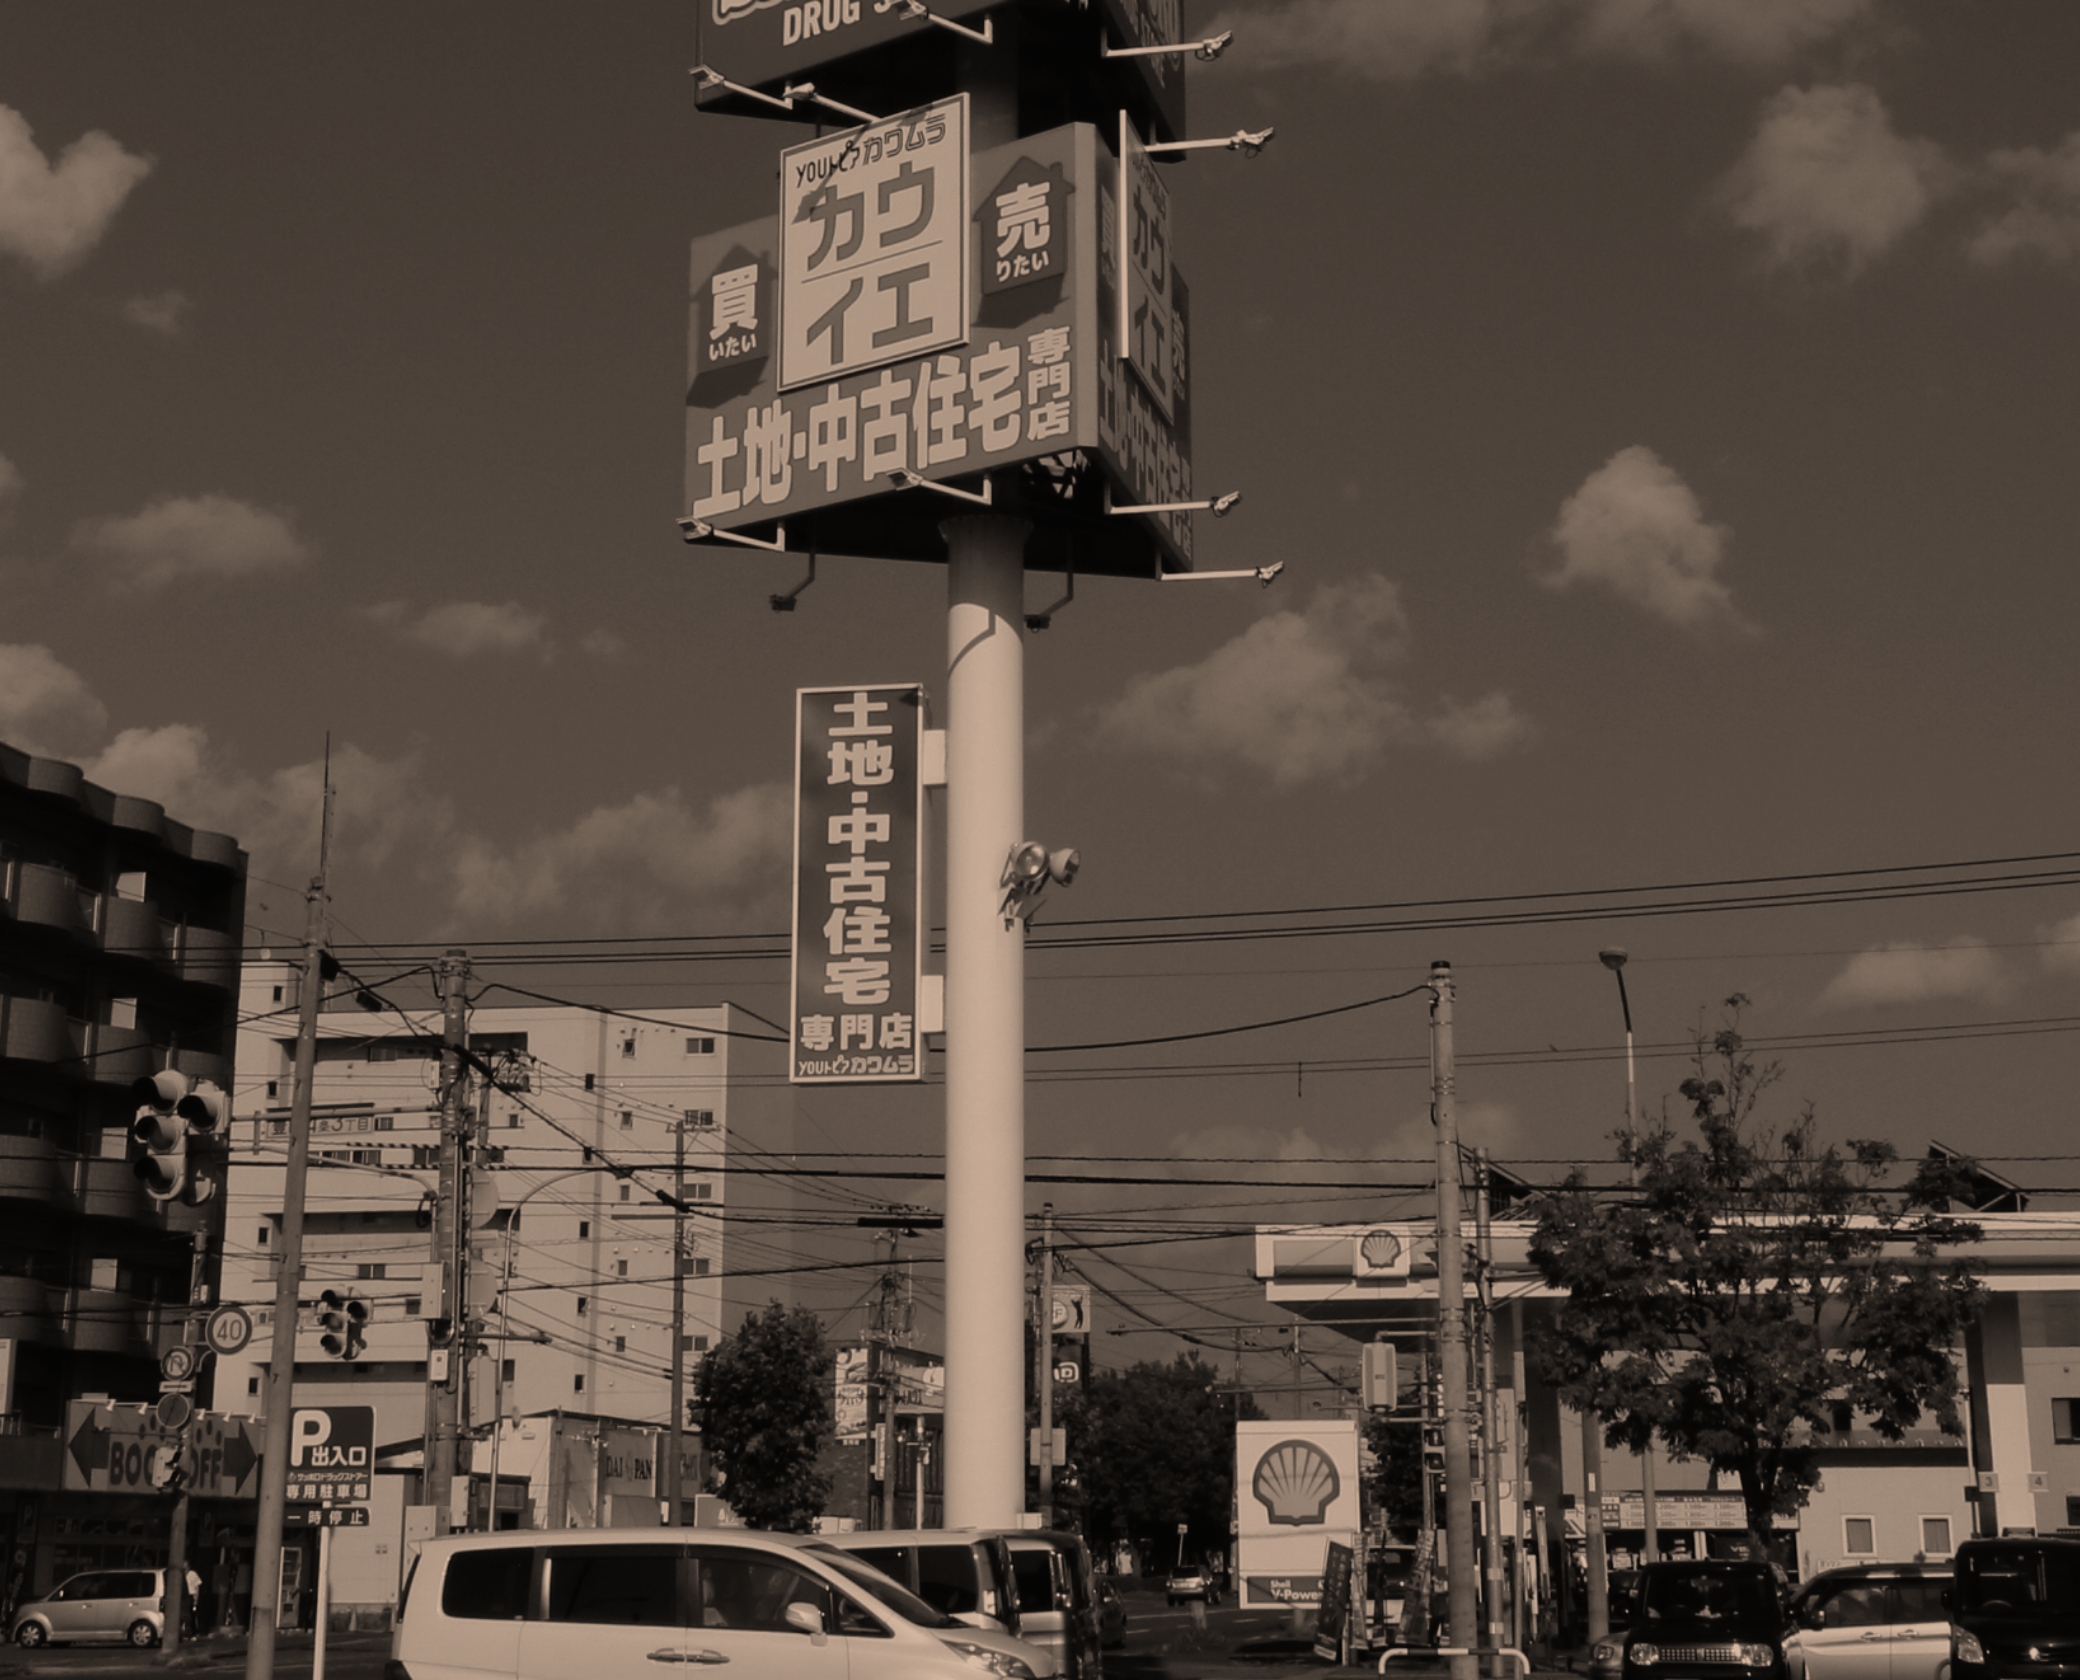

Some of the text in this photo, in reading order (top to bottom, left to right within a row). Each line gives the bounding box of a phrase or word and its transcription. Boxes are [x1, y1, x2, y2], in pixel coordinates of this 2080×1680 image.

[783, 0, 861, 46] DRUG
[996, 181, 1050, 258] 売
[996, 250, 1049, 282] りたい
[709, 263, 758, 340] 買
[806, 262, 933, 366] イエ
[708, 333, 757, 361] いたい
[1027, 325, 1072, 441] 専門店
[800, 1011, 913, 1052] 専門店
[217, 1319, 243, 1340] 40
[290, 1409, 332, 1467] P
[311, 1446, 367, 1467] 出入口
[286, 1484, 368, 1499] 専用駐車場
[1984, 1475, 2044, 1488] 3 4
[287, 1510, 364, 1526] 一時停止
